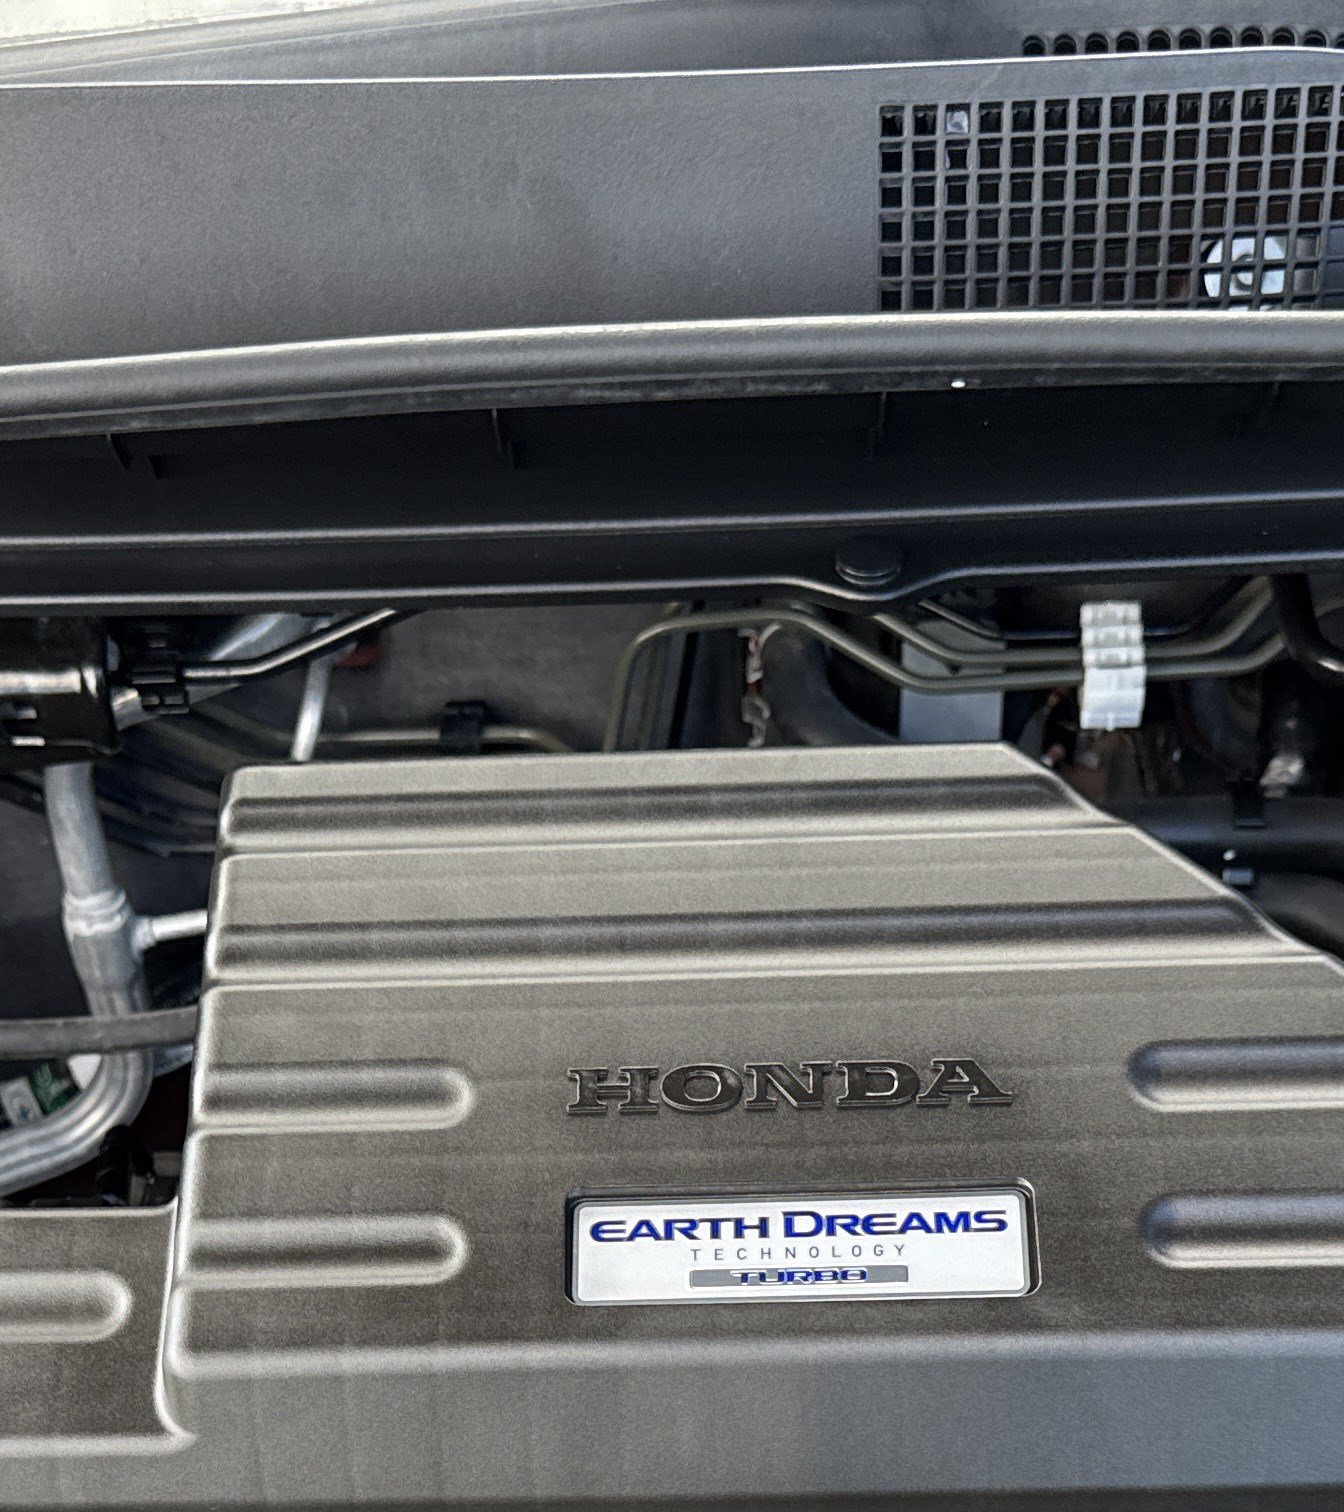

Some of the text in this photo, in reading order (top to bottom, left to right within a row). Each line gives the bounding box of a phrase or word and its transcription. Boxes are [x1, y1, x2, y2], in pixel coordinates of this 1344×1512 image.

[567, 1057, 1013, 1117] HONDA
[589, 1209, 1009, 1243] EARTH DREAMS
[690, 1243, 908, 1263] TECHNOLOGY
[729, 1268, 868, 1286] TURBO
